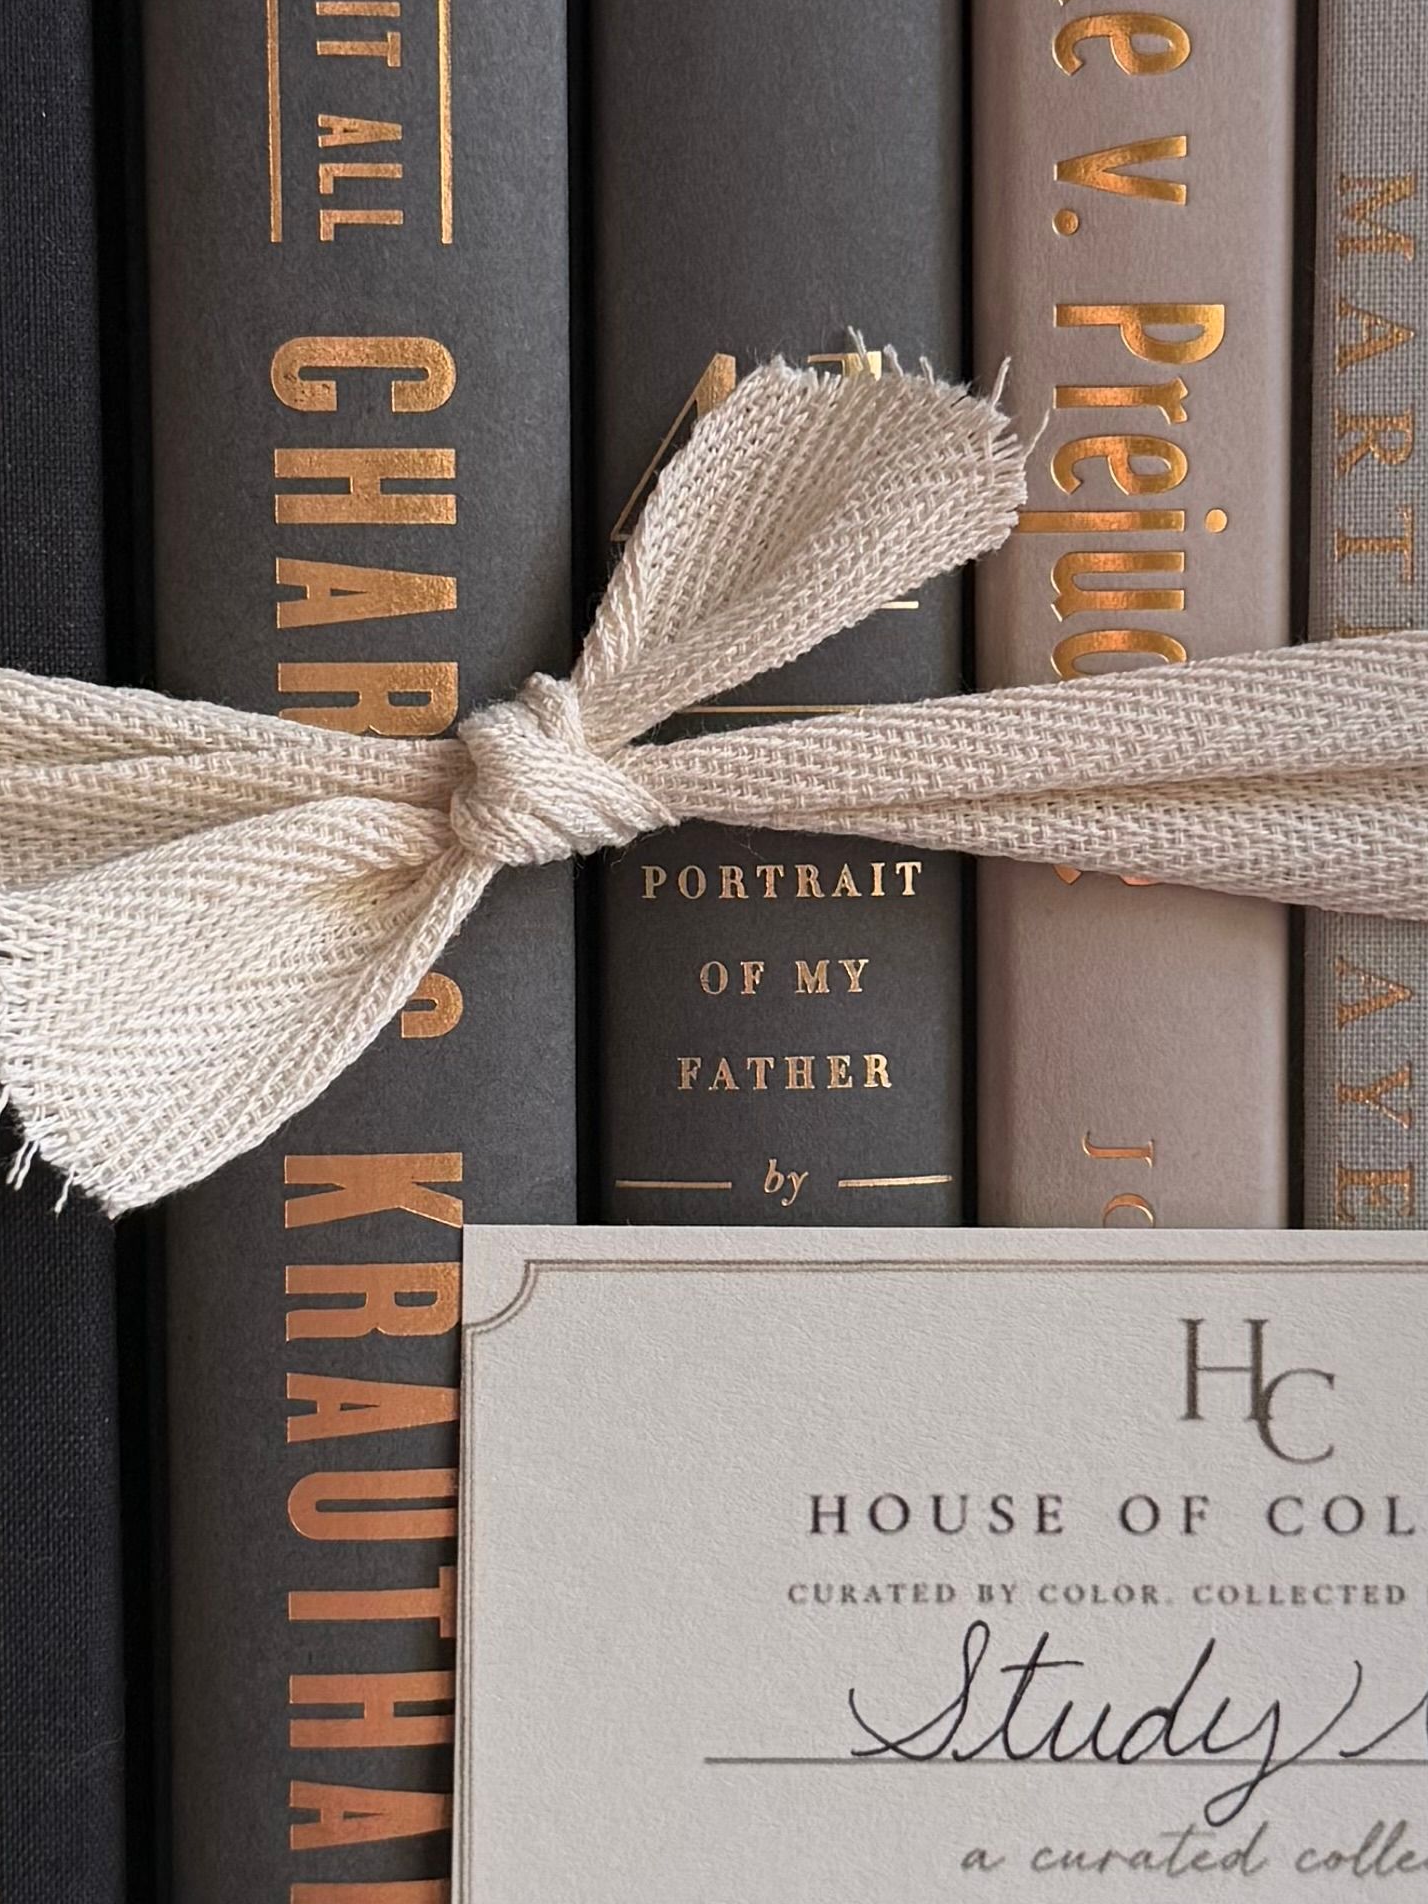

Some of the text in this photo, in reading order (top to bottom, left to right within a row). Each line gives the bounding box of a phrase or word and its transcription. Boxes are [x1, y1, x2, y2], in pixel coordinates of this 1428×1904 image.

[314, 0, 402, 70] IT
[316, 112, 404, 243] ALL
[1053, 135, 1188, 236] v.
[642, 861, 922, 900] PORTRAIT
[698, 958, 869, 995] OF MY
[678, 1052, 893, 1093] FATHER
[761, 1158, 810, 1205] by
[808, 1492, 1066, 1537] HOUSE
[1117, 1493, 1211, 1537] OF
[786, 1581, 957, 1607] CURATED
[977, 1582, 1019, 1607] BY
[1037, 1583, 1174, 1607] COLOR.
[1192, 1583, 1408, 1607] COLLECTED
[850, 1619, 1363, 1828] Study
[959, 1846, 1008, 1875] a
[1029, 1823, 1270, 1880] curated
